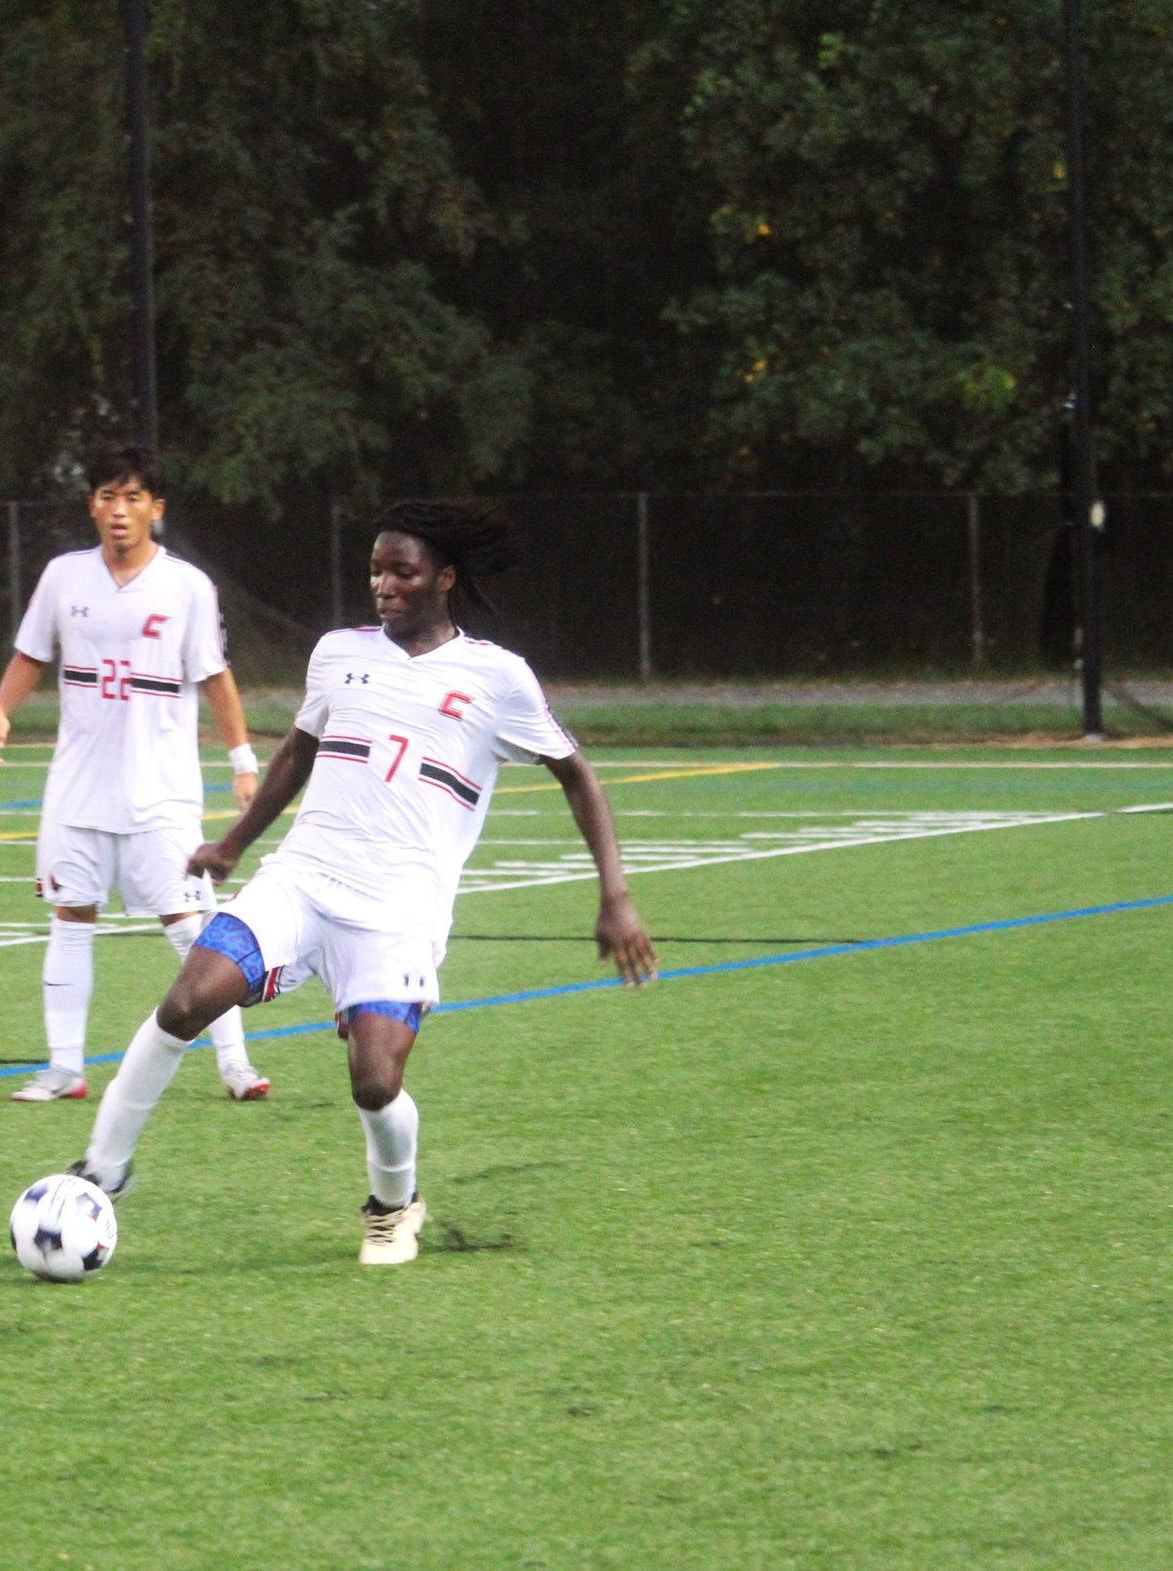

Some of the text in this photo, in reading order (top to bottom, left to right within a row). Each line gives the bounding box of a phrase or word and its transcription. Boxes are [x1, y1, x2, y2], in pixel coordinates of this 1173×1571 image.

[142, 614, 171, 640] C
[101, 659, 131, 701] 22
[439, 690, 474, 722] C
[384, 734, 409, 782] 7
